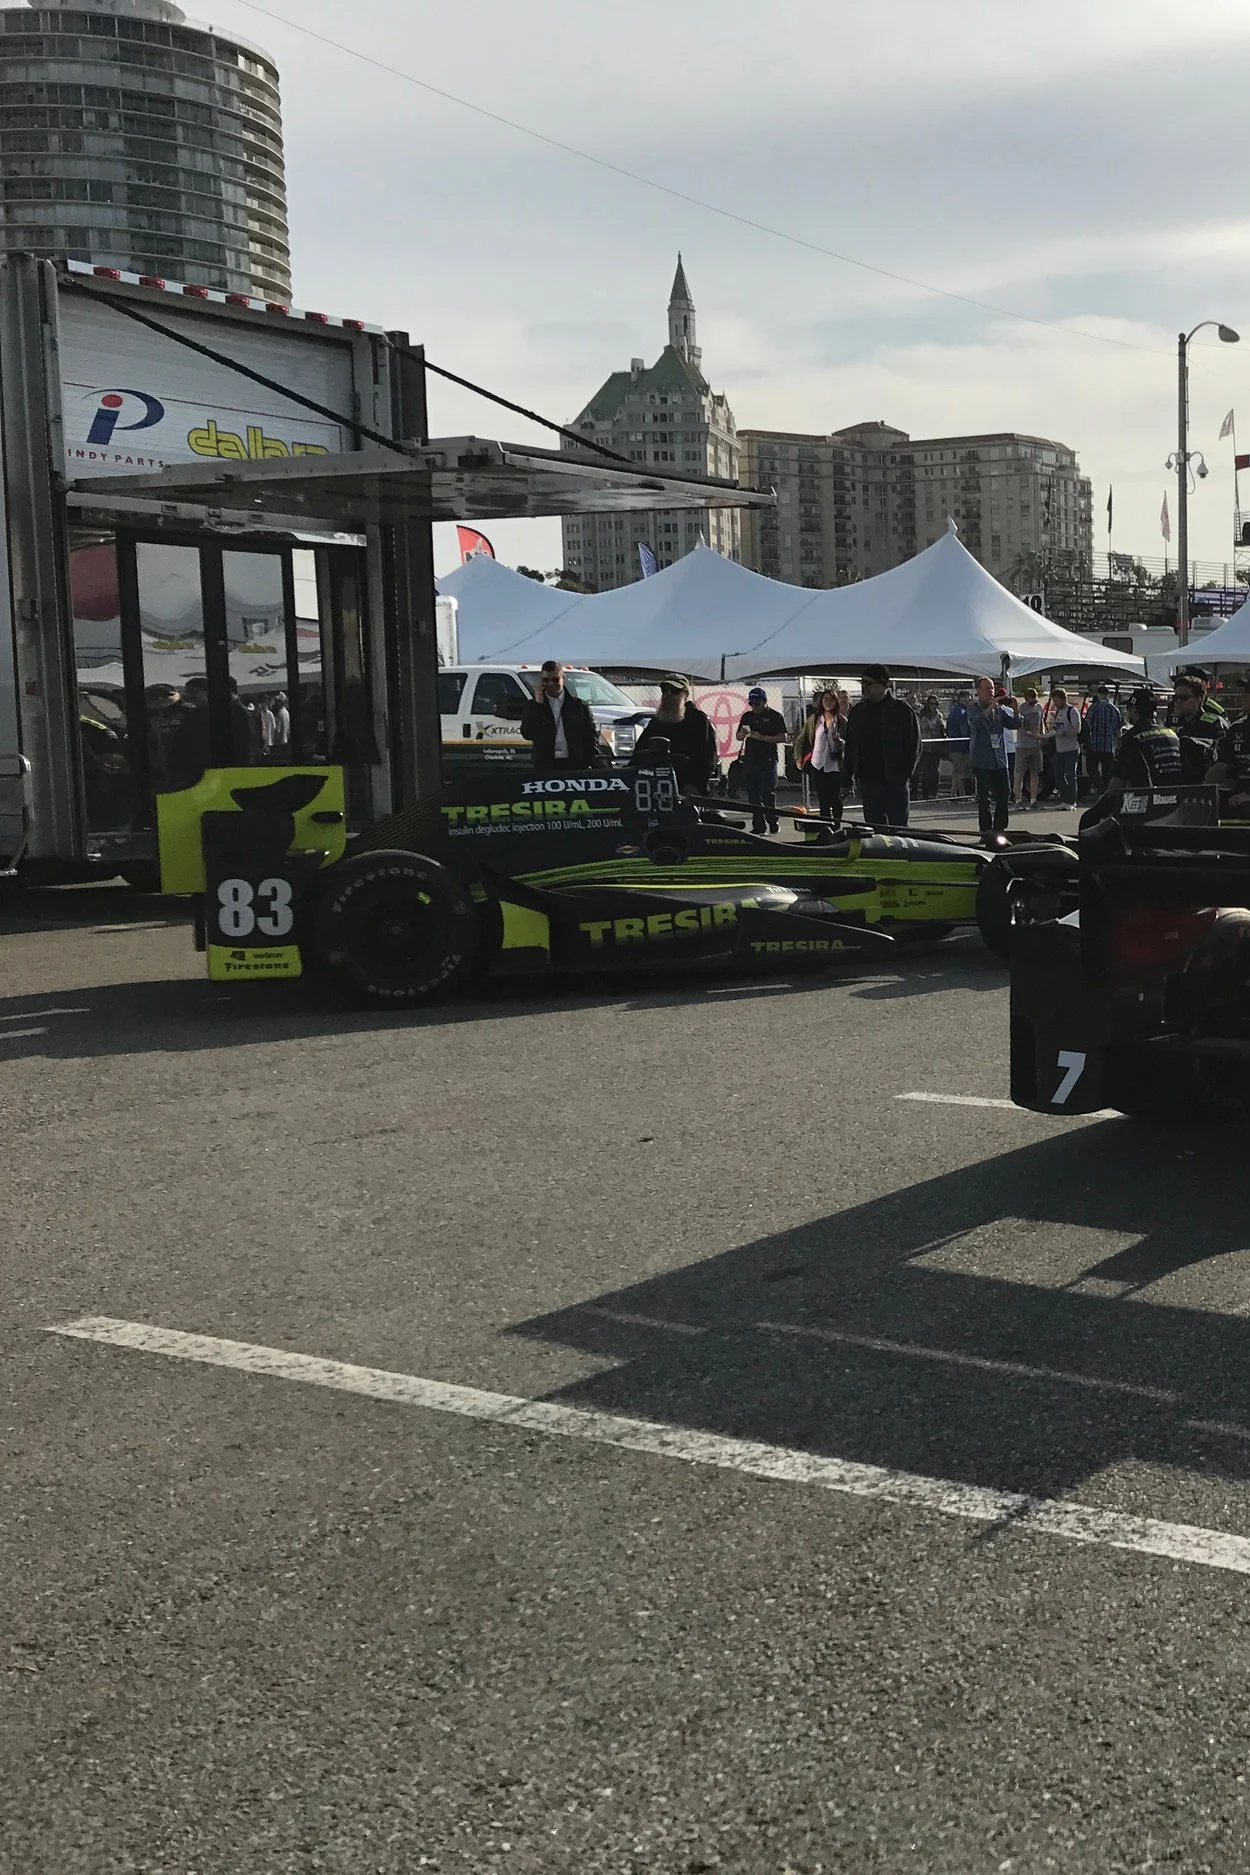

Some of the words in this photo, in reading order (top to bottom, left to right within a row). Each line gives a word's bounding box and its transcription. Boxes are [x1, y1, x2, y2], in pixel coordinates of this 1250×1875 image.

[67, 449, 107, 462] INDY
[115, 454, 164, 469] PARTS
[521, 778, 630, 795] HONDA
[1152, 793, 1177, 806] Blauer
[440, 799, 622, 826] TRESIBA
[512, 822, 546, 835] injection
[547, 820, 562, 831] 100
[586, 818, 602, 829] 200
[217, 877, 295, 937] 83
[579, 897, 760, 948] TRESIB
[751, 939, 862, 952] TRESIBA
[252, 951, 285, 960] verizon
[224, 961, 290, 972] Firestone
[1050, 1050, 1087, 1105] 7
